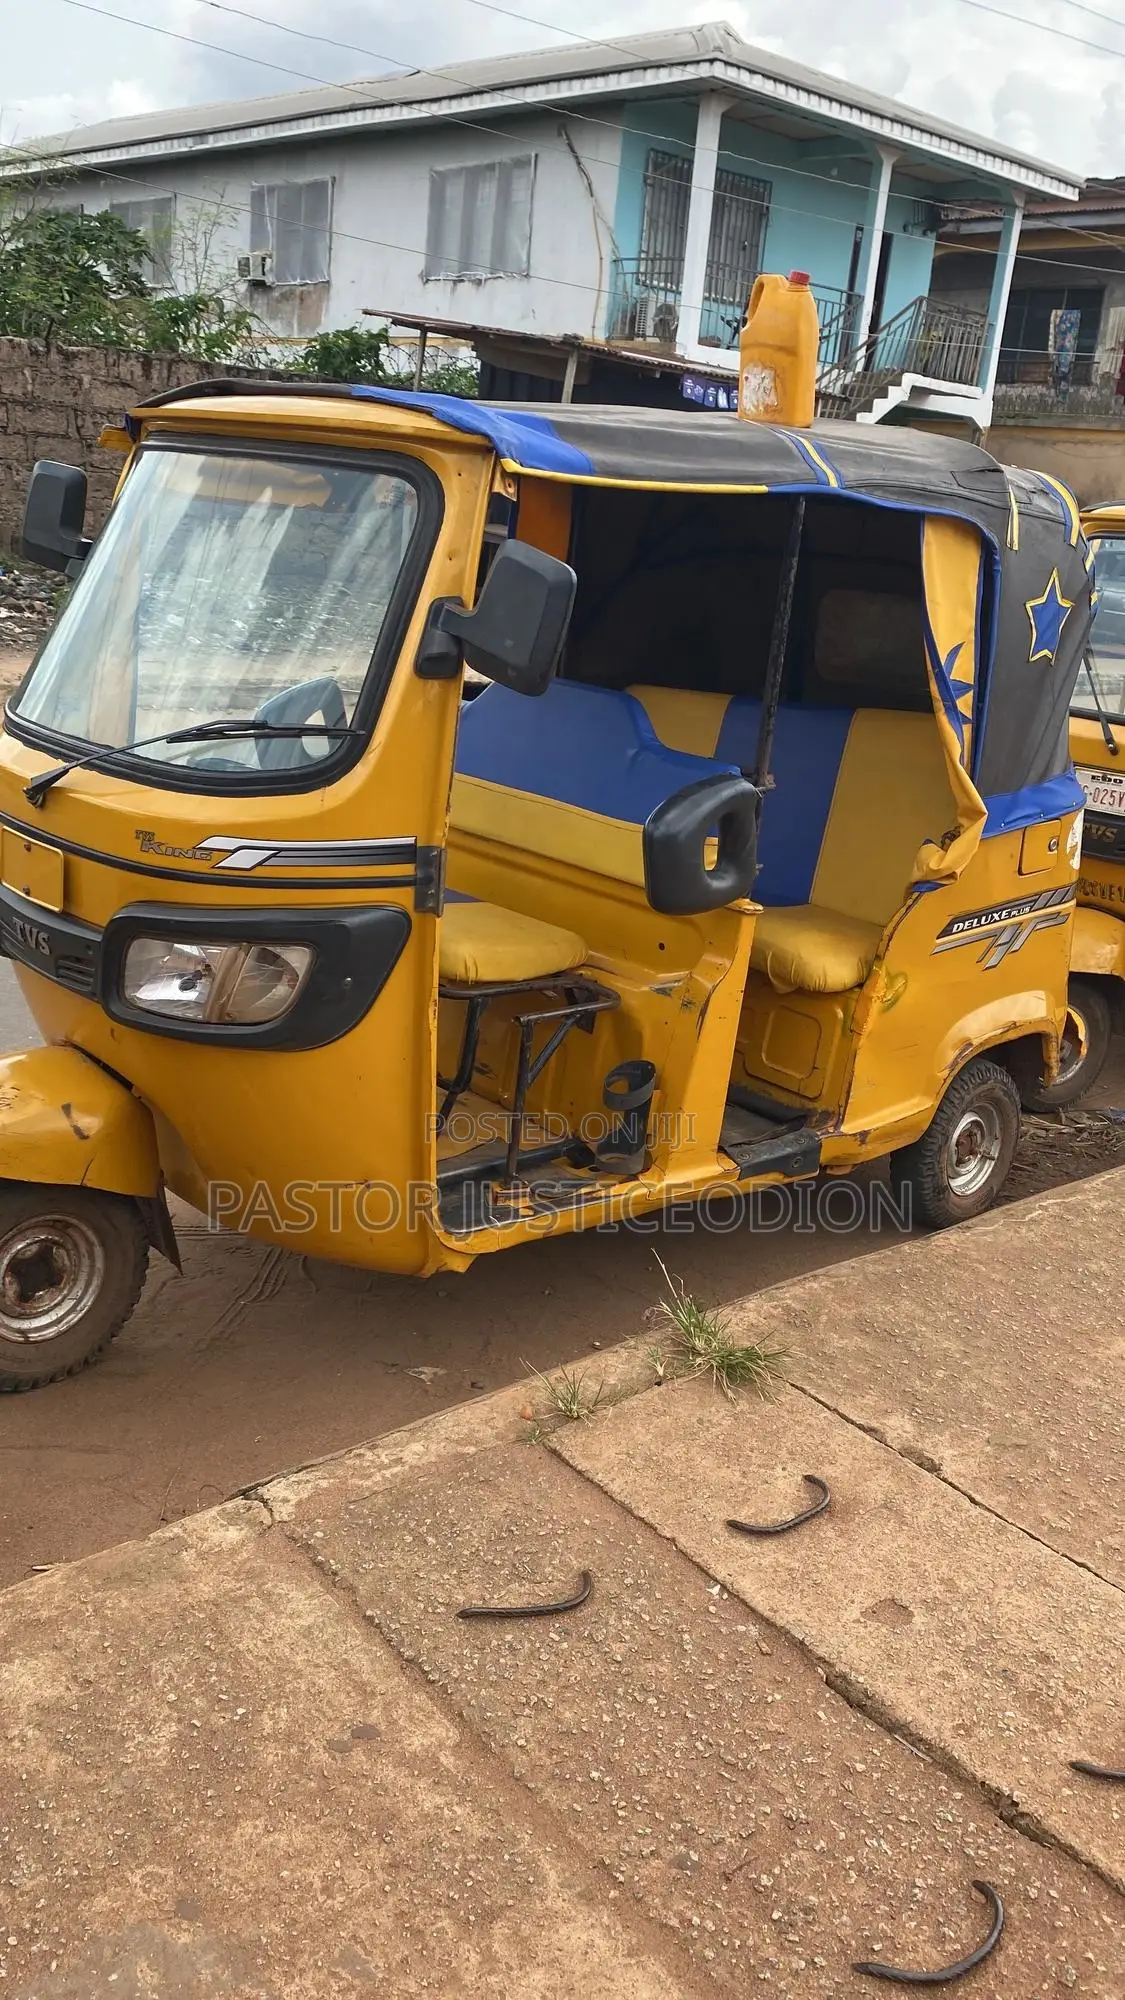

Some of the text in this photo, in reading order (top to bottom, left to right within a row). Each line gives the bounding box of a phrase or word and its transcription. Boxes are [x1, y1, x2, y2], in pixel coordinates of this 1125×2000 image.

[135, 829, 155, 841] TVS
[952, 906, 1031, 933] DELUXE PLUS
[11, 916, 51, 956] TVS
